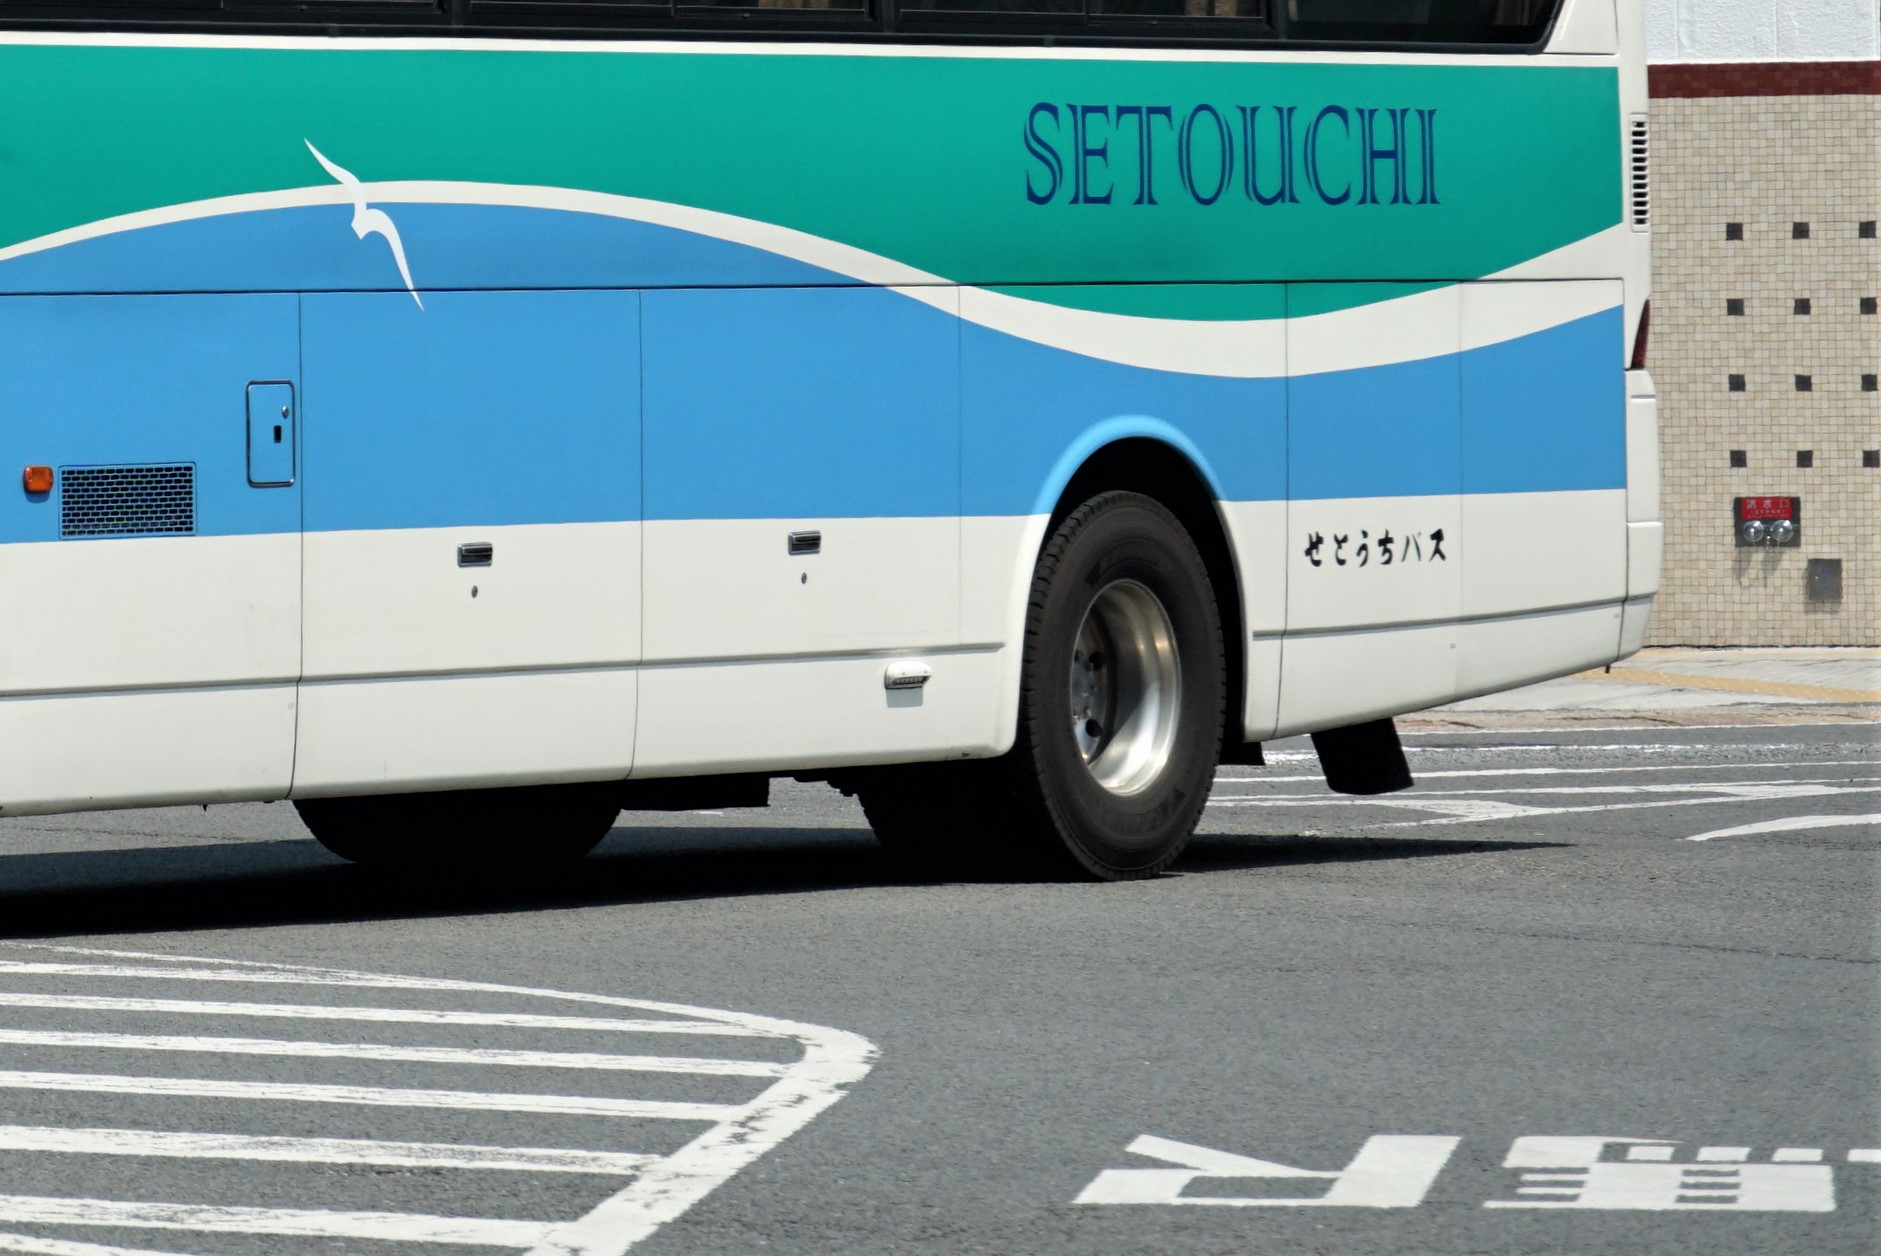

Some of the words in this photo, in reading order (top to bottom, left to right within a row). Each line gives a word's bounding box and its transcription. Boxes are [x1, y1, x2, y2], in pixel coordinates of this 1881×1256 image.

[1023, 101, 1442, 206] SETOUCHI
[1304, 528, 1447, 567] せとうちバス
